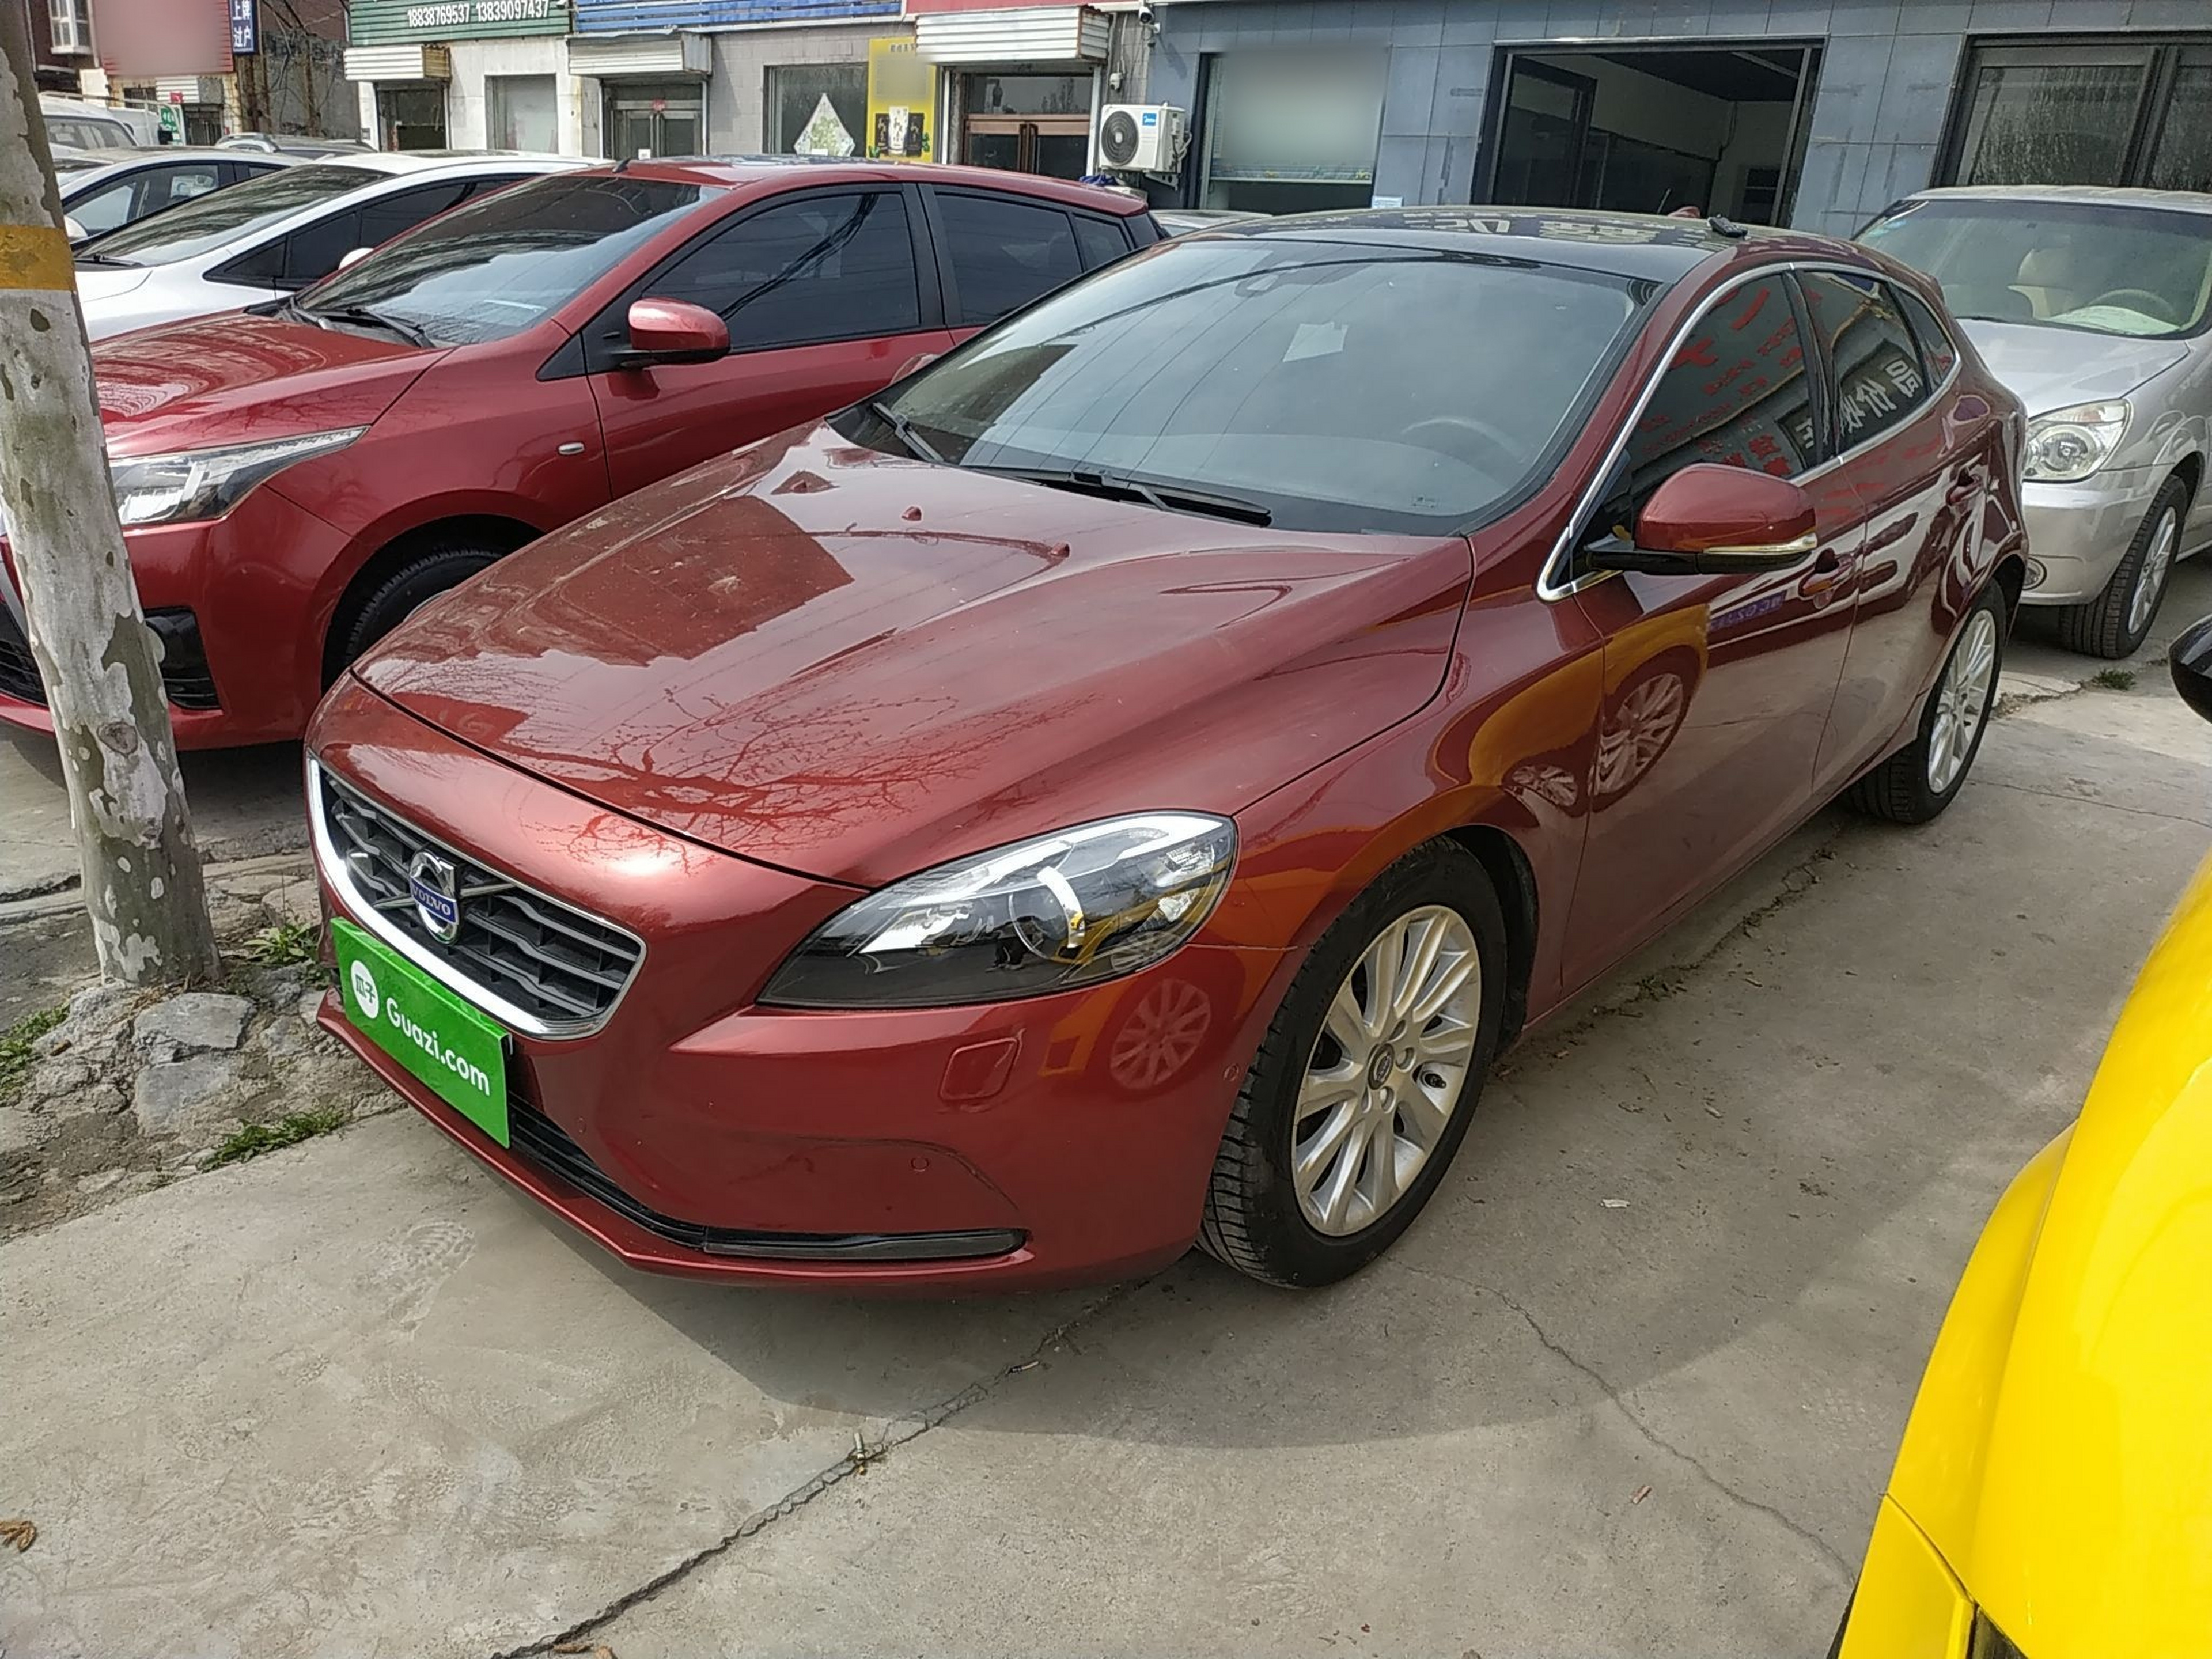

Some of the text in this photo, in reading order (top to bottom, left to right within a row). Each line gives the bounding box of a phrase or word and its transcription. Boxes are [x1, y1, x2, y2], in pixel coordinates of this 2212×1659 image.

[407, 0, 548, 27] 18838769537 13839097437
[412, 885, 451, 916] VOLVO
[355, 973, 376, 1004] 瓜子
[386, 997, 491, 1096] Guazi.com
